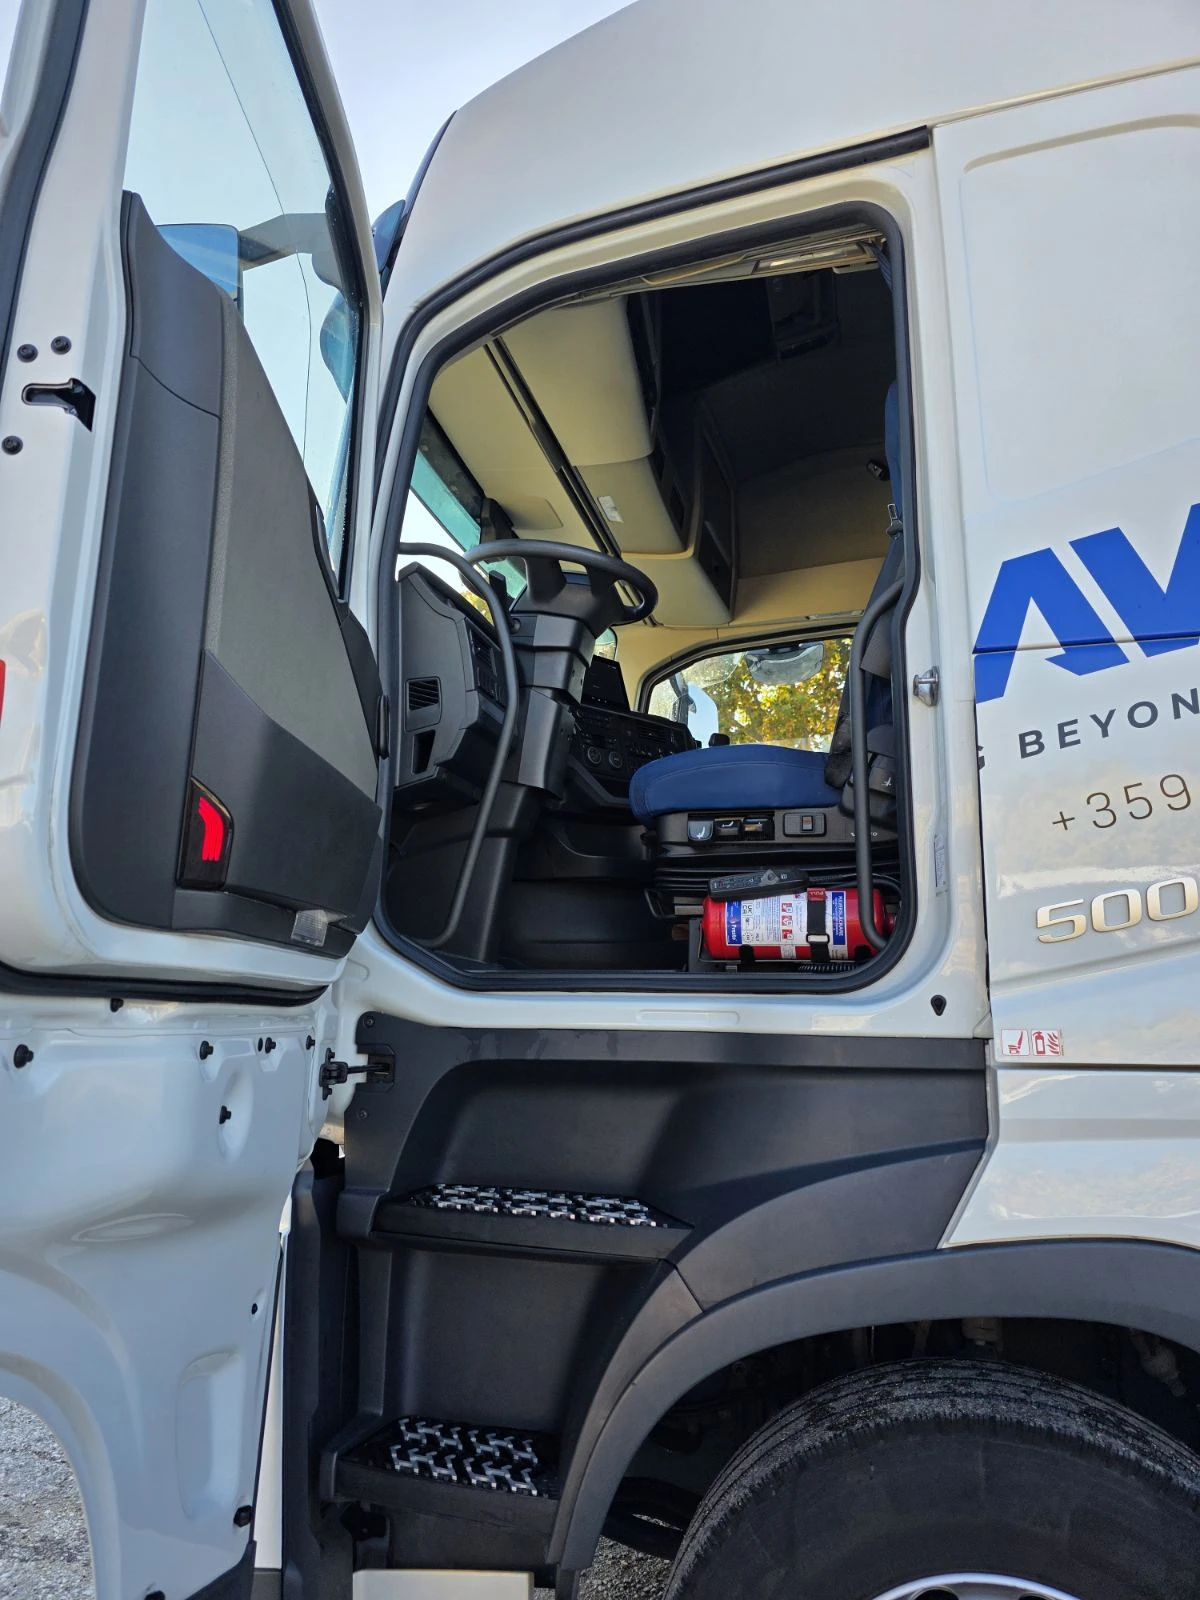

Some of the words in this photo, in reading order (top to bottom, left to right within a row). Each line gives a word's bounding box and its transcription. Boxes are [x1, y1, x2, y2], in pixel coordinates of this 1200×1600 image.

[1018, 688, 1200, 759] BEYON
[1052, 774, 1192, 830] +359
[1036, 876, 1199, 943] 500
